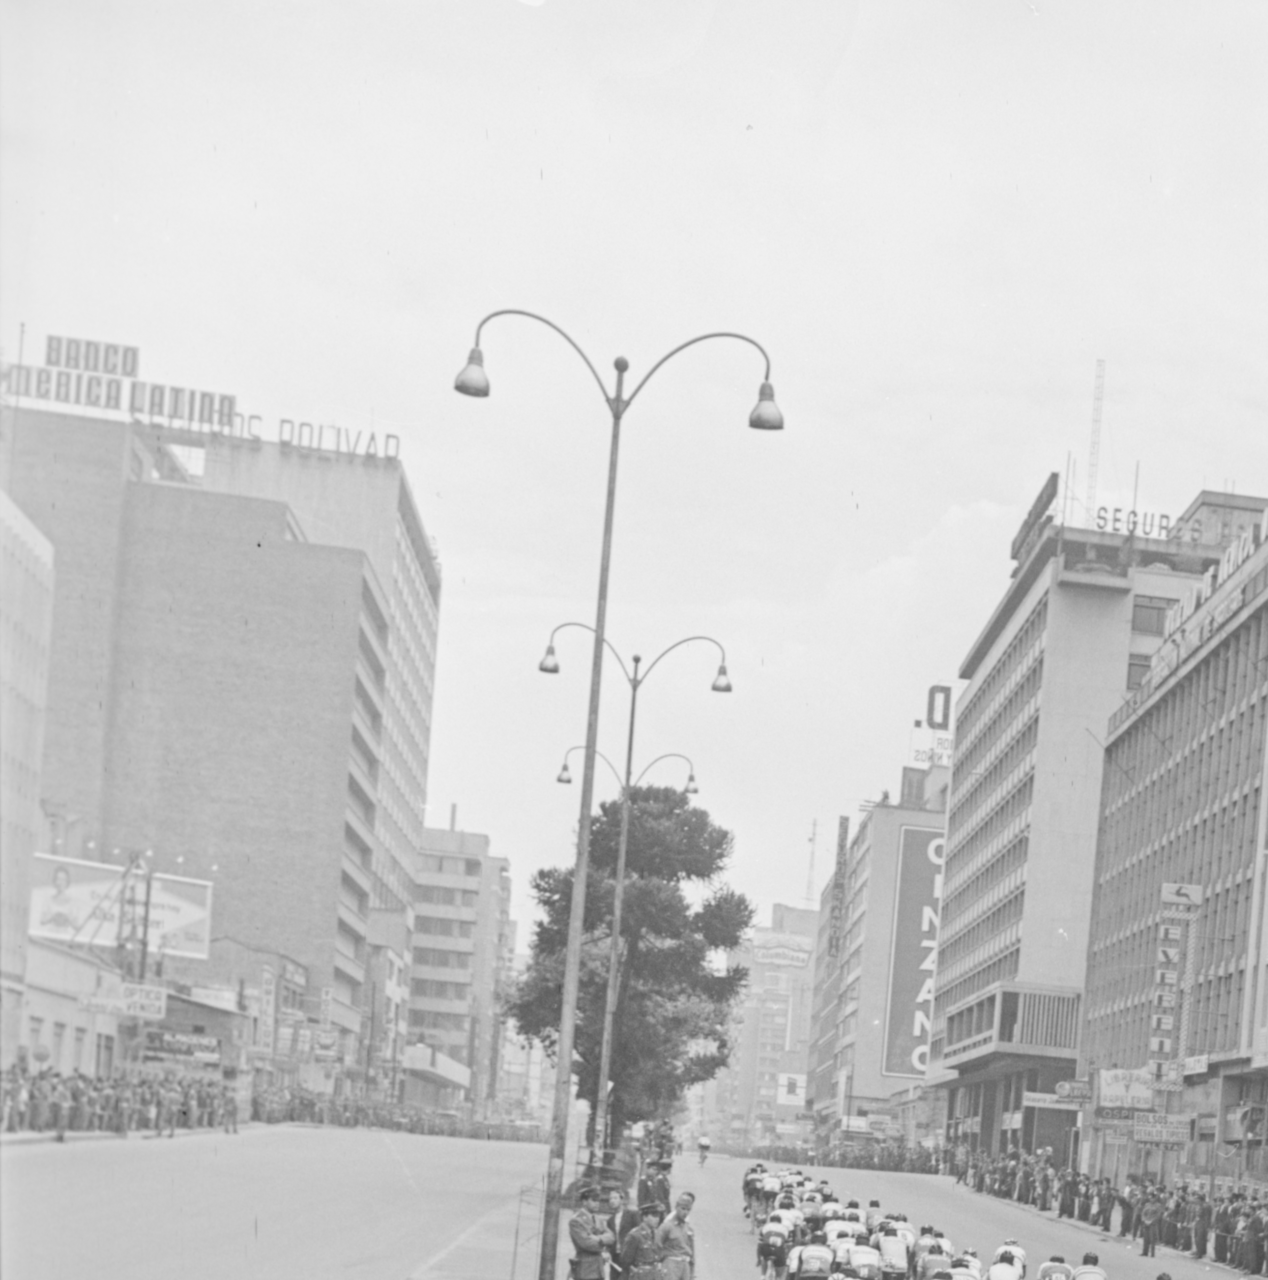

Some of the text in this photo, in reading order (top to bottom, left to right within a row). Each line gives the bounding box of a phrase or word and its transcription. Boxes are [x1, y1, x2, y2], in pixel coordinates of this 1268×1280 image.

[0, 364, 121, 410] MERICA
[910, 837, 945, 1072] CINZANO
[1136, 1114, 1168, 1125] BOLSOS
